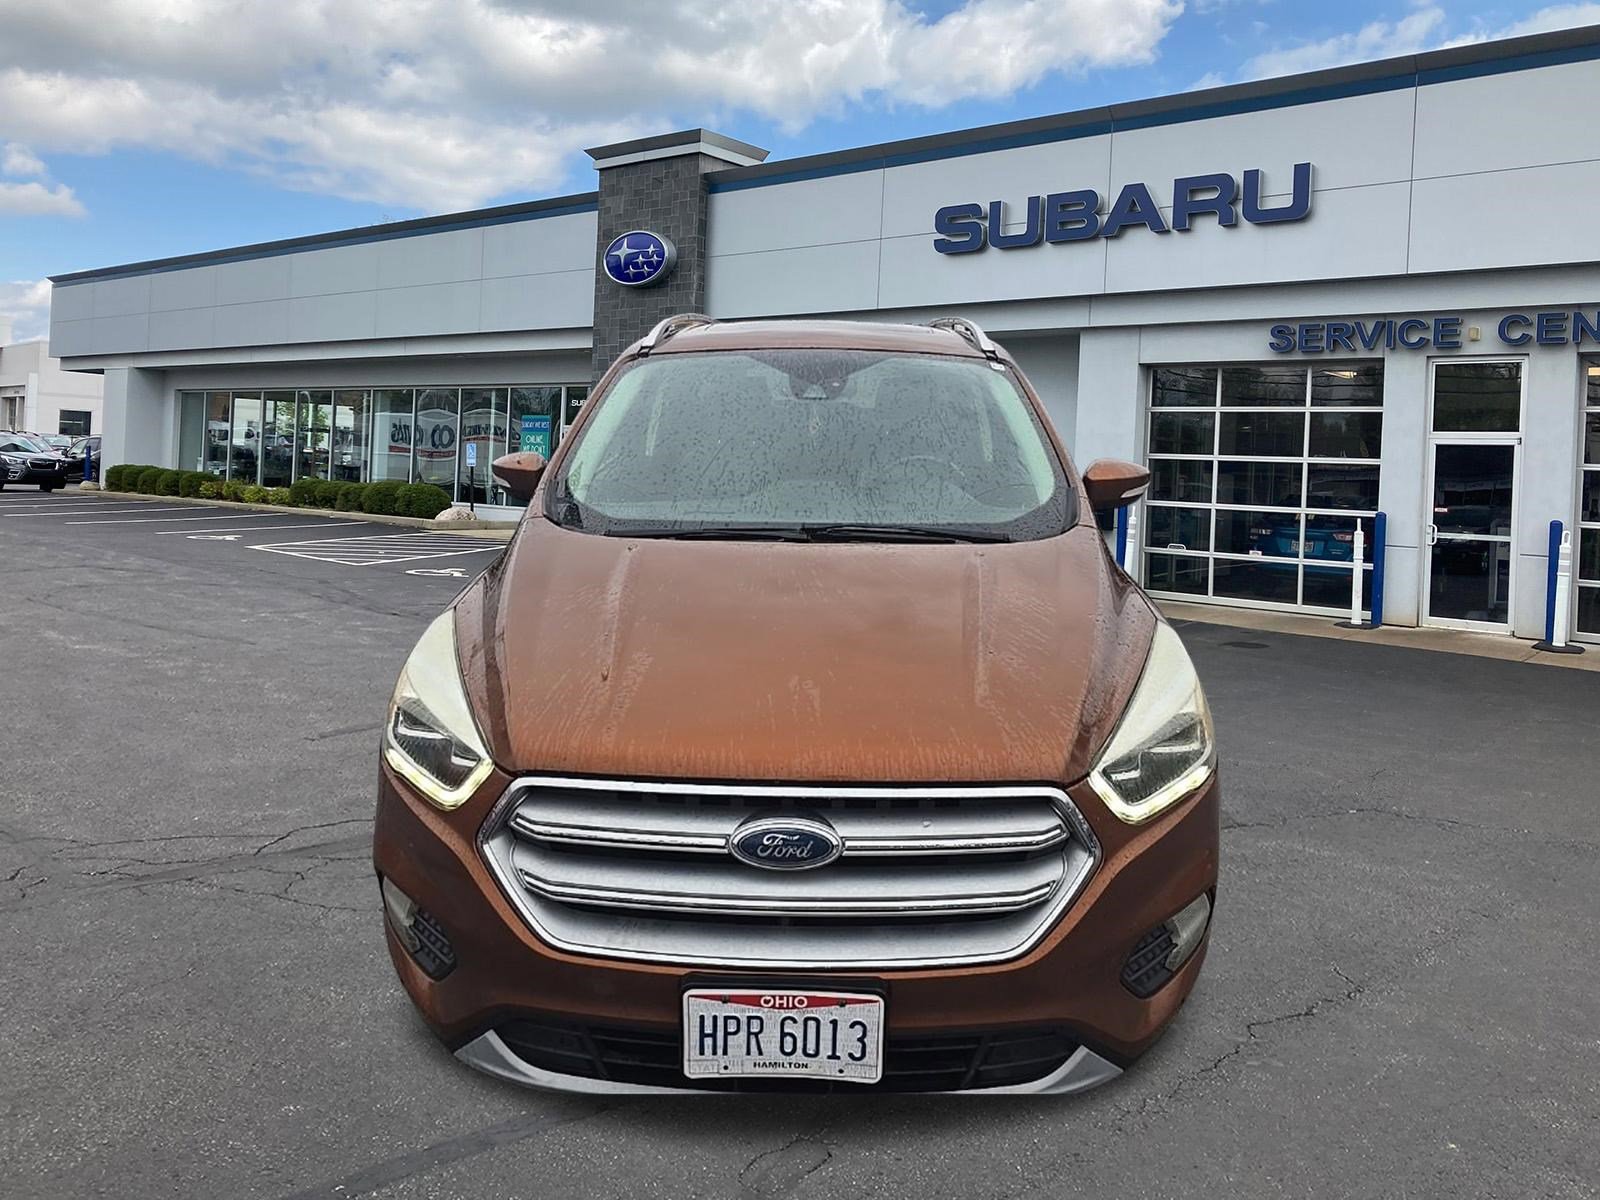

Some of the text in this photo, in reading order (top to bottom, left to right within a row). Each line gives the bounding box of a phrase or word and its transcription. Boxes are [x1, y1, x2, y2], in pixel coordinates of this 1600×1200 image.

[933, 162, 1313, 255] SUBARU
[1269, 317, 1463, 353] SERVICE
[757, 833, 814, 858] Ford
[760, 995, 808, 1009] OHIO
[699, 1014, 868, 1062] HPR 6013
[752, 1061, 809, 1070] HAMILTON
